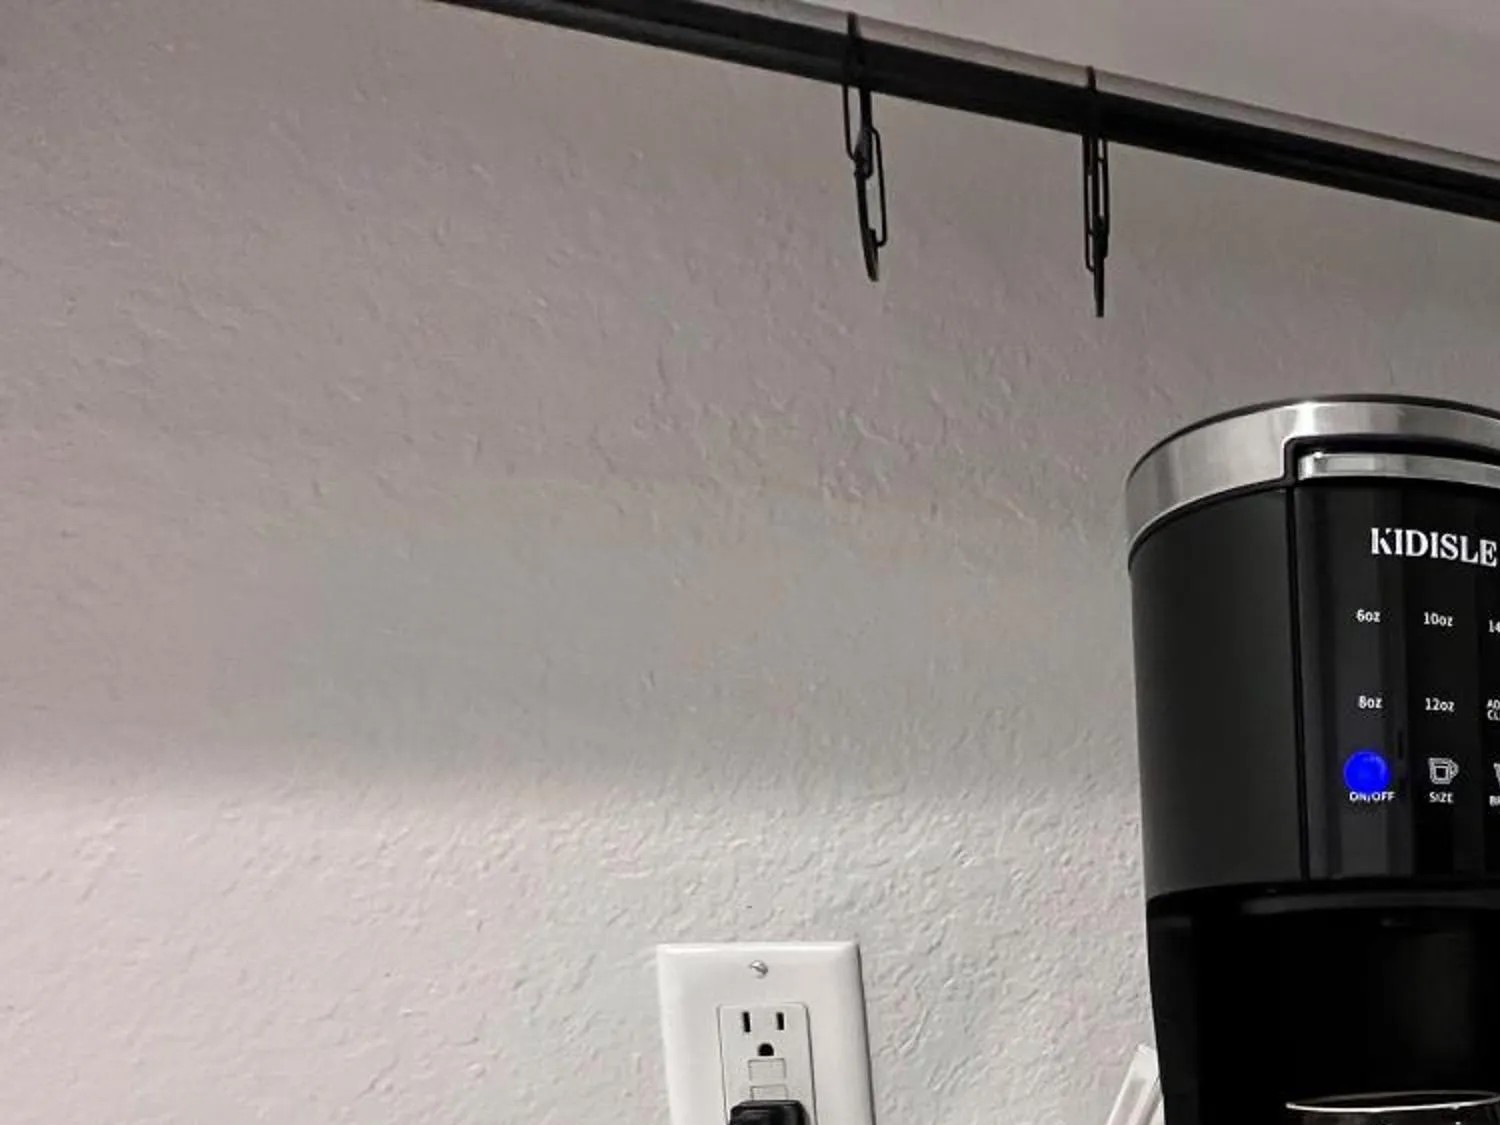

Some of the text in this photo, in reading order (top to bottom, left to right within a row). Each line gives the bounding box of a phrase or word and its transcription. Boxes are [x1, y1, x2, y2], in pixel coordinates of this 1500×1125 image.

[1370, 527, 1498, 567] KIDISLE
[1356, 608, 1381, 623] 6oz
[1423, 611, 1454, 628] 10oz
[1357, 695, 1383, 710] 8oz
[1424, 697, 1455, 713] 12oz
[1429, 791, 1454, 803] SIZE
